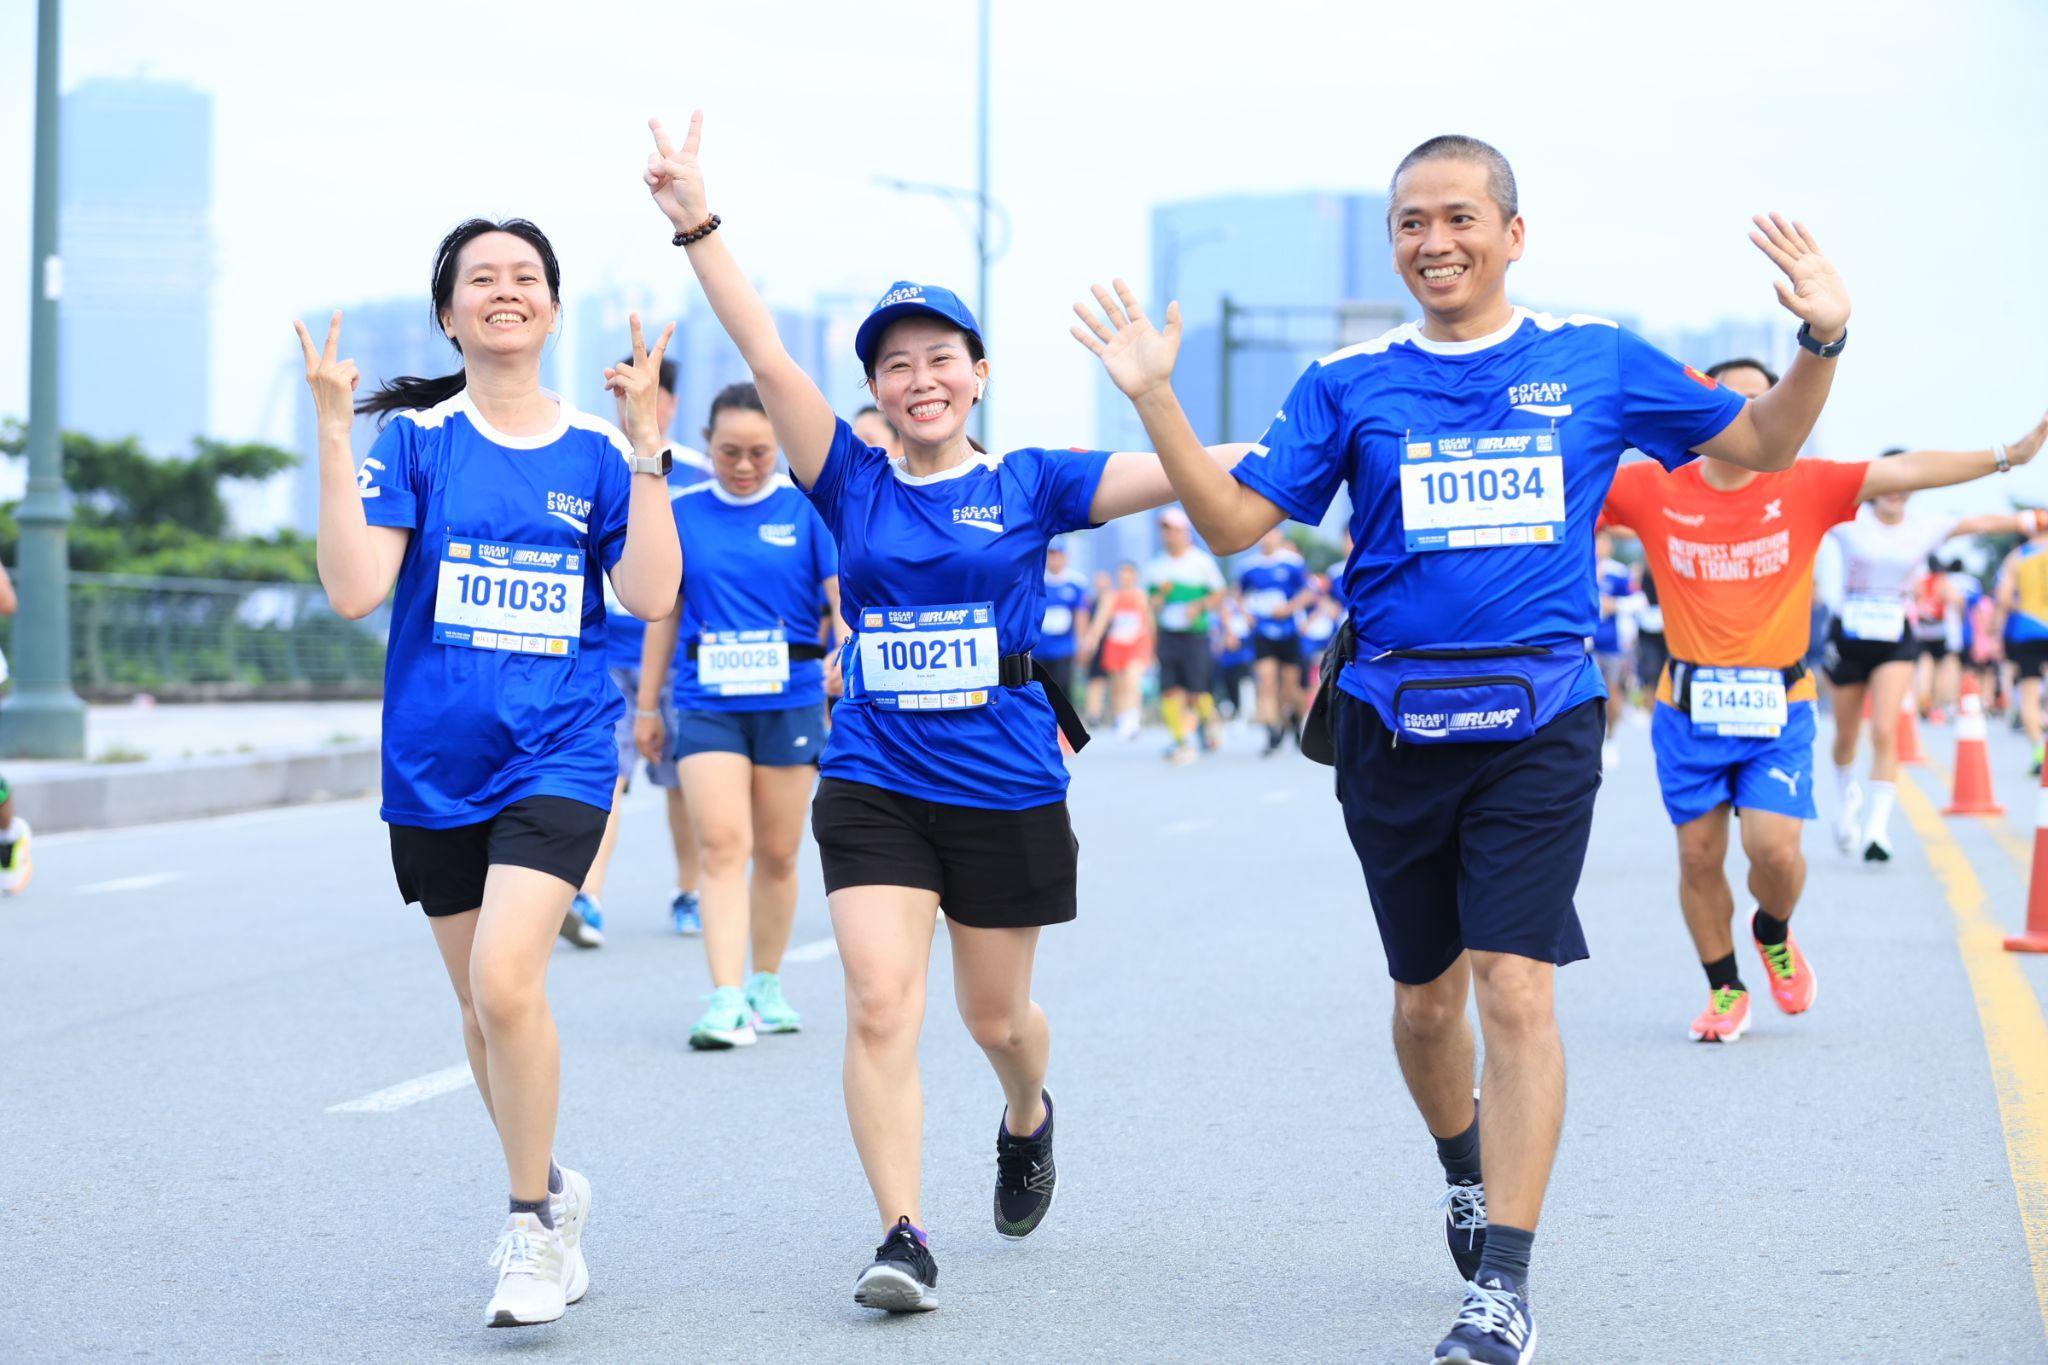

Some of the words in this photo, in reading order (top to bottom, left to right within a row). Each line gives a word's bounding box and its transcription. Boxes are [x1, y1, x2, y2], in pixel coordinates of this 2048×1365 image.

[1508, 382, 1567, 396] POCARI
[1510, 391, 1562, 404] SWEAT
[1420, 467, 1545, 504] 101034
[547, 491, 594, 511] POCAR
[952, 505, 1002, 515] POCARI
[952, 511, 998, 520] SWEAT
[478, 543, 510, 554] POCARI
[478, 550, 506, 558] SWEAT
[1699, 558, 1750, 580] TRANG
[457, 574, 567, 613] 101033
[709, 649, 779, 669] 100028
[877, 637, 977, 670] 100211
[1702, 689, 1778, 709] 214436
[1404, 713, 1445, 721] POCARI
[1404, 720, 1441, 728] SWEAT
